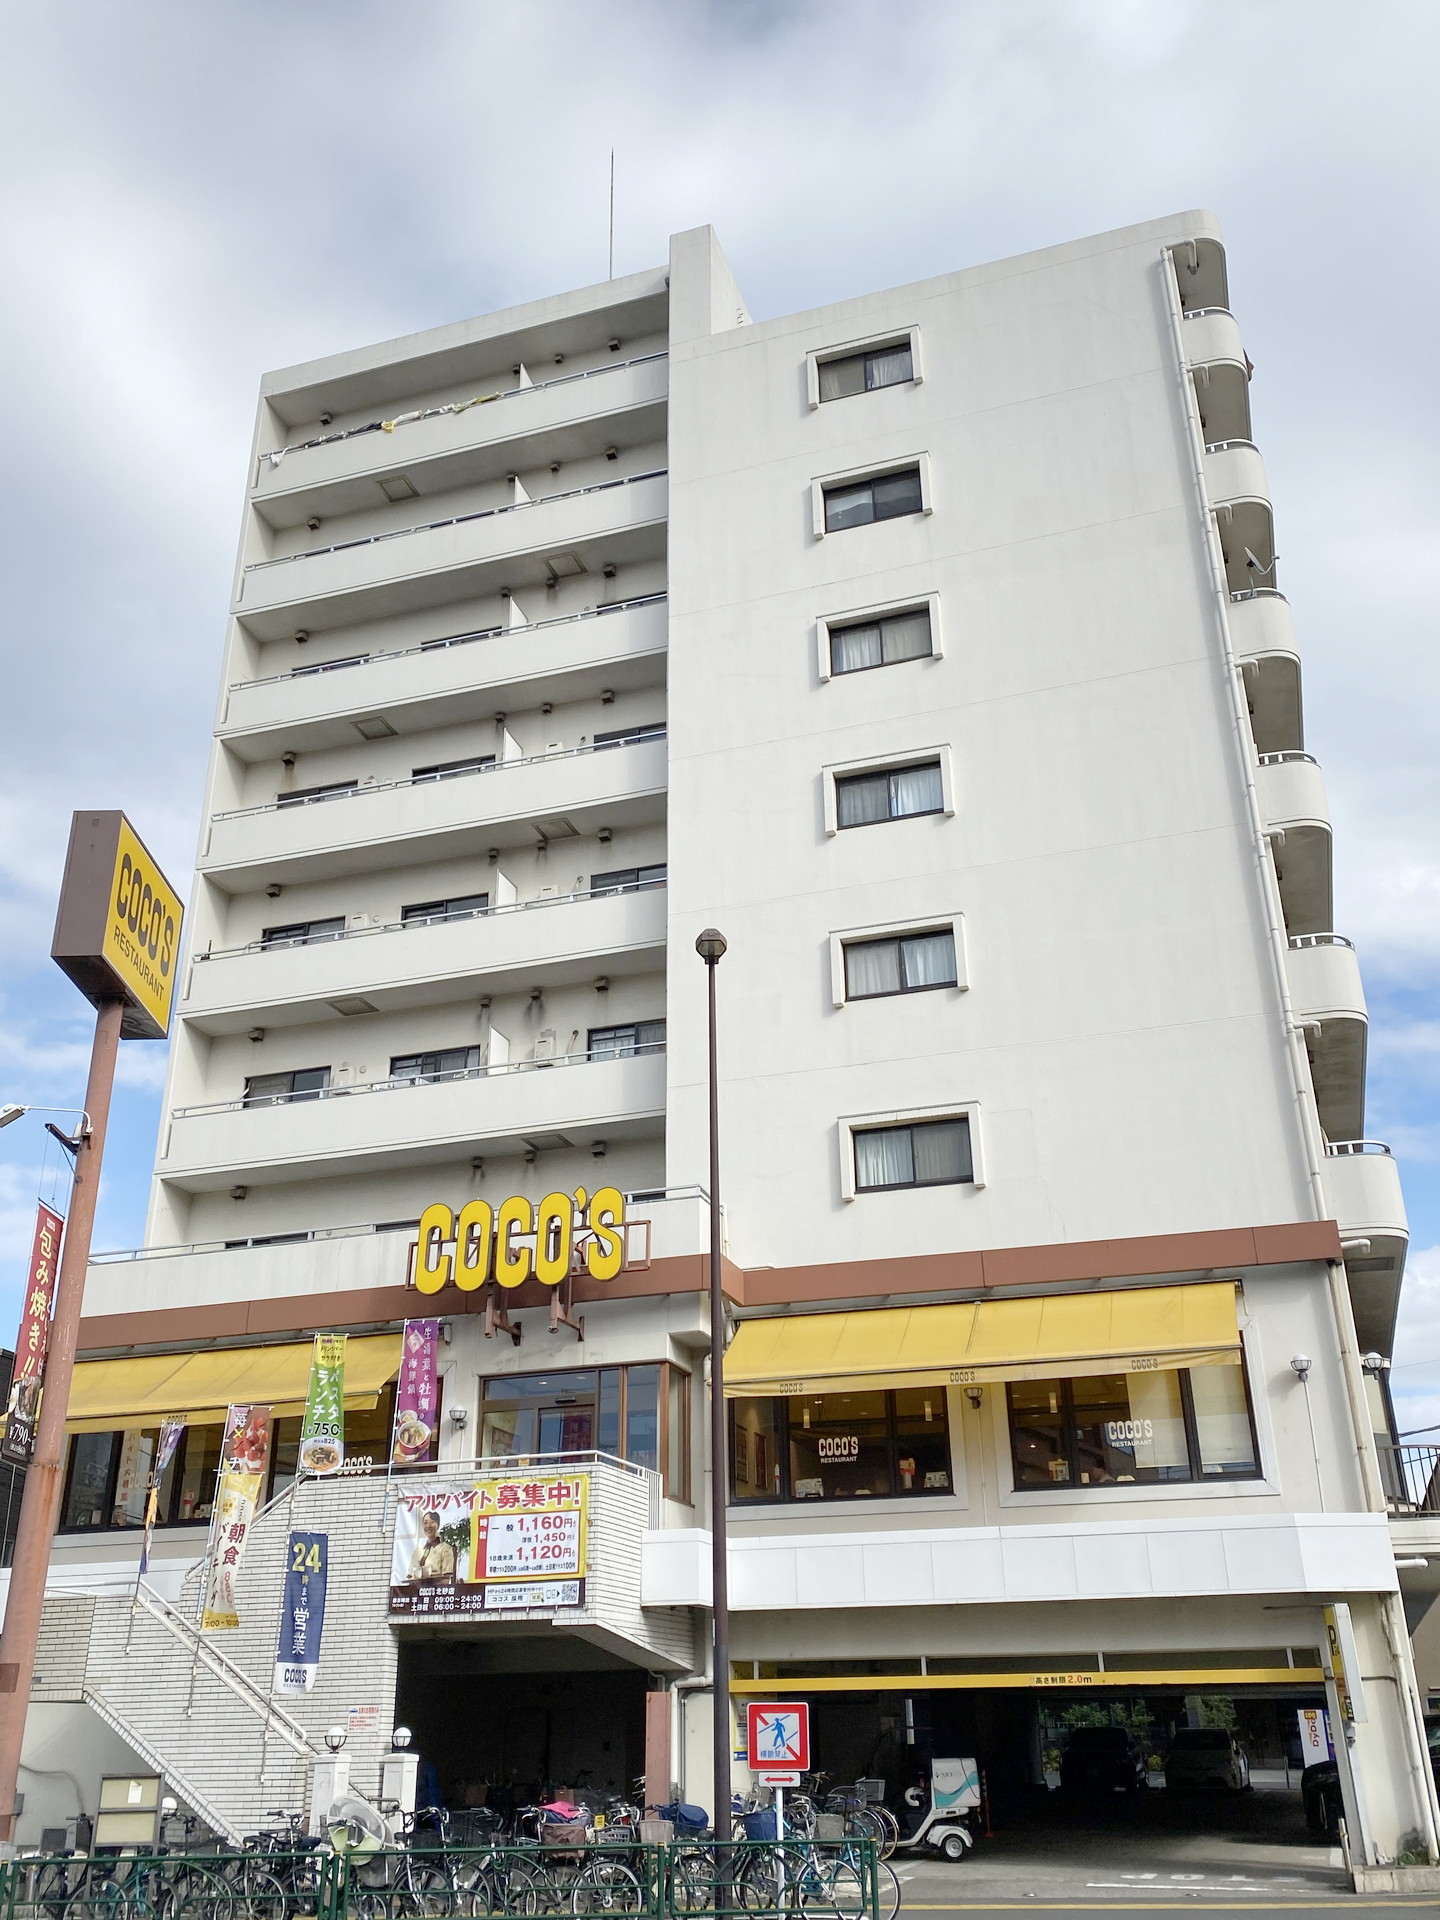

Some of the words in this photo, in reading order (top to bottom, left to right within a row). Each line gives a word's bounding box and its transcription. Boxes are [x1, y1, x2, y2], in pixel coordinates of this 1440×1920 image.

[116, 853, 174, 977] COCO'S
[113, 925, 164, 1001] RESTAURANT
[415, 1186, 624, 1295] COCO'S
[1131, 1357, 1159, 1370] COCO'S
[950, 1370, 976, 1383] COCO'S
[312, 1370, 328, 1420] ランチ
[779, 1382, 803, 1394] COCO'S
[1108, 1419, 1153, 1441] COCO'S
[818, 1436, 859, 1456] COCO'S
[1111, 1439, 1152, 1448] RESTAURANT
[337, 1456, 373, 1476] OCO'S
[820, 1456, 857, 1464] RESTAURANT
[222, 1523, 246, 1566] 朝食
[291, 1542, 322, 1573] 24
[760, 1749, 789, 1759] 横断禁止
